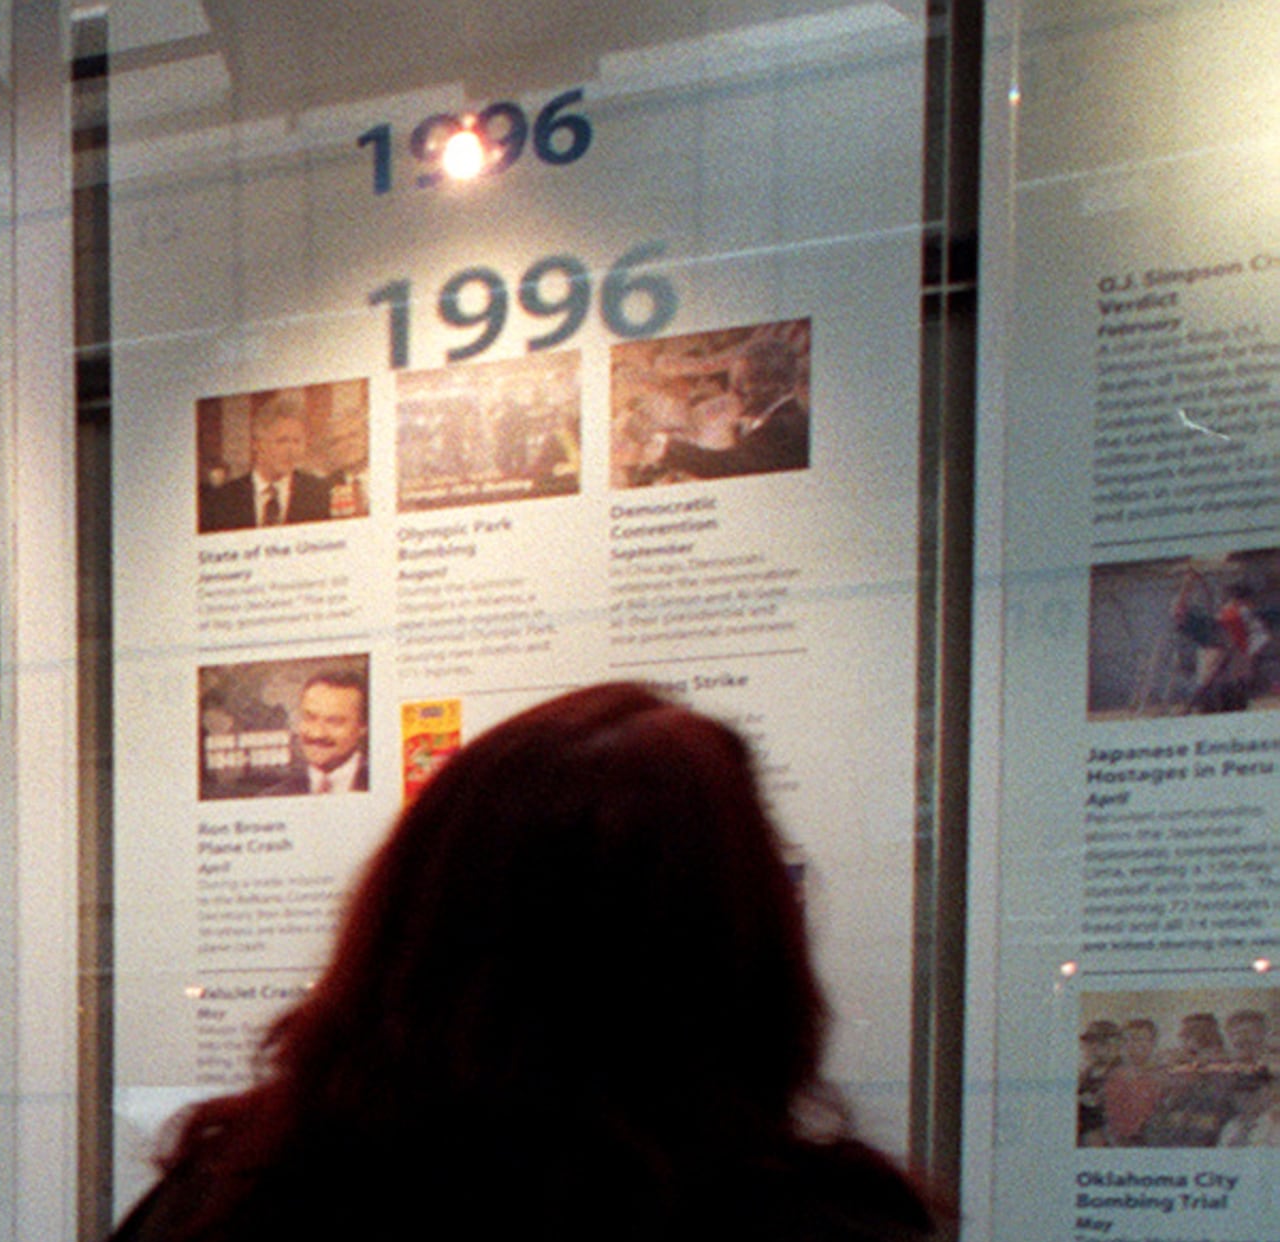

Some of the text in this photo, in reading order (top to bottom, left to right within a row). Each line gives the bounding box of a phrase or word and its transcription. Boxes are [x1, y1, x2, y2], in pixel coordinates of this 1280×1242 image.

[367, 240, 678, 371] 1996
[1087, 766, 1189, 786] Hostages
[1222, 759, 1276, 777] Peru
[1075, 1170, 1239, 1190] Oklahoma City
[1075, 1192, 1229, 1214] Bombing Trial
